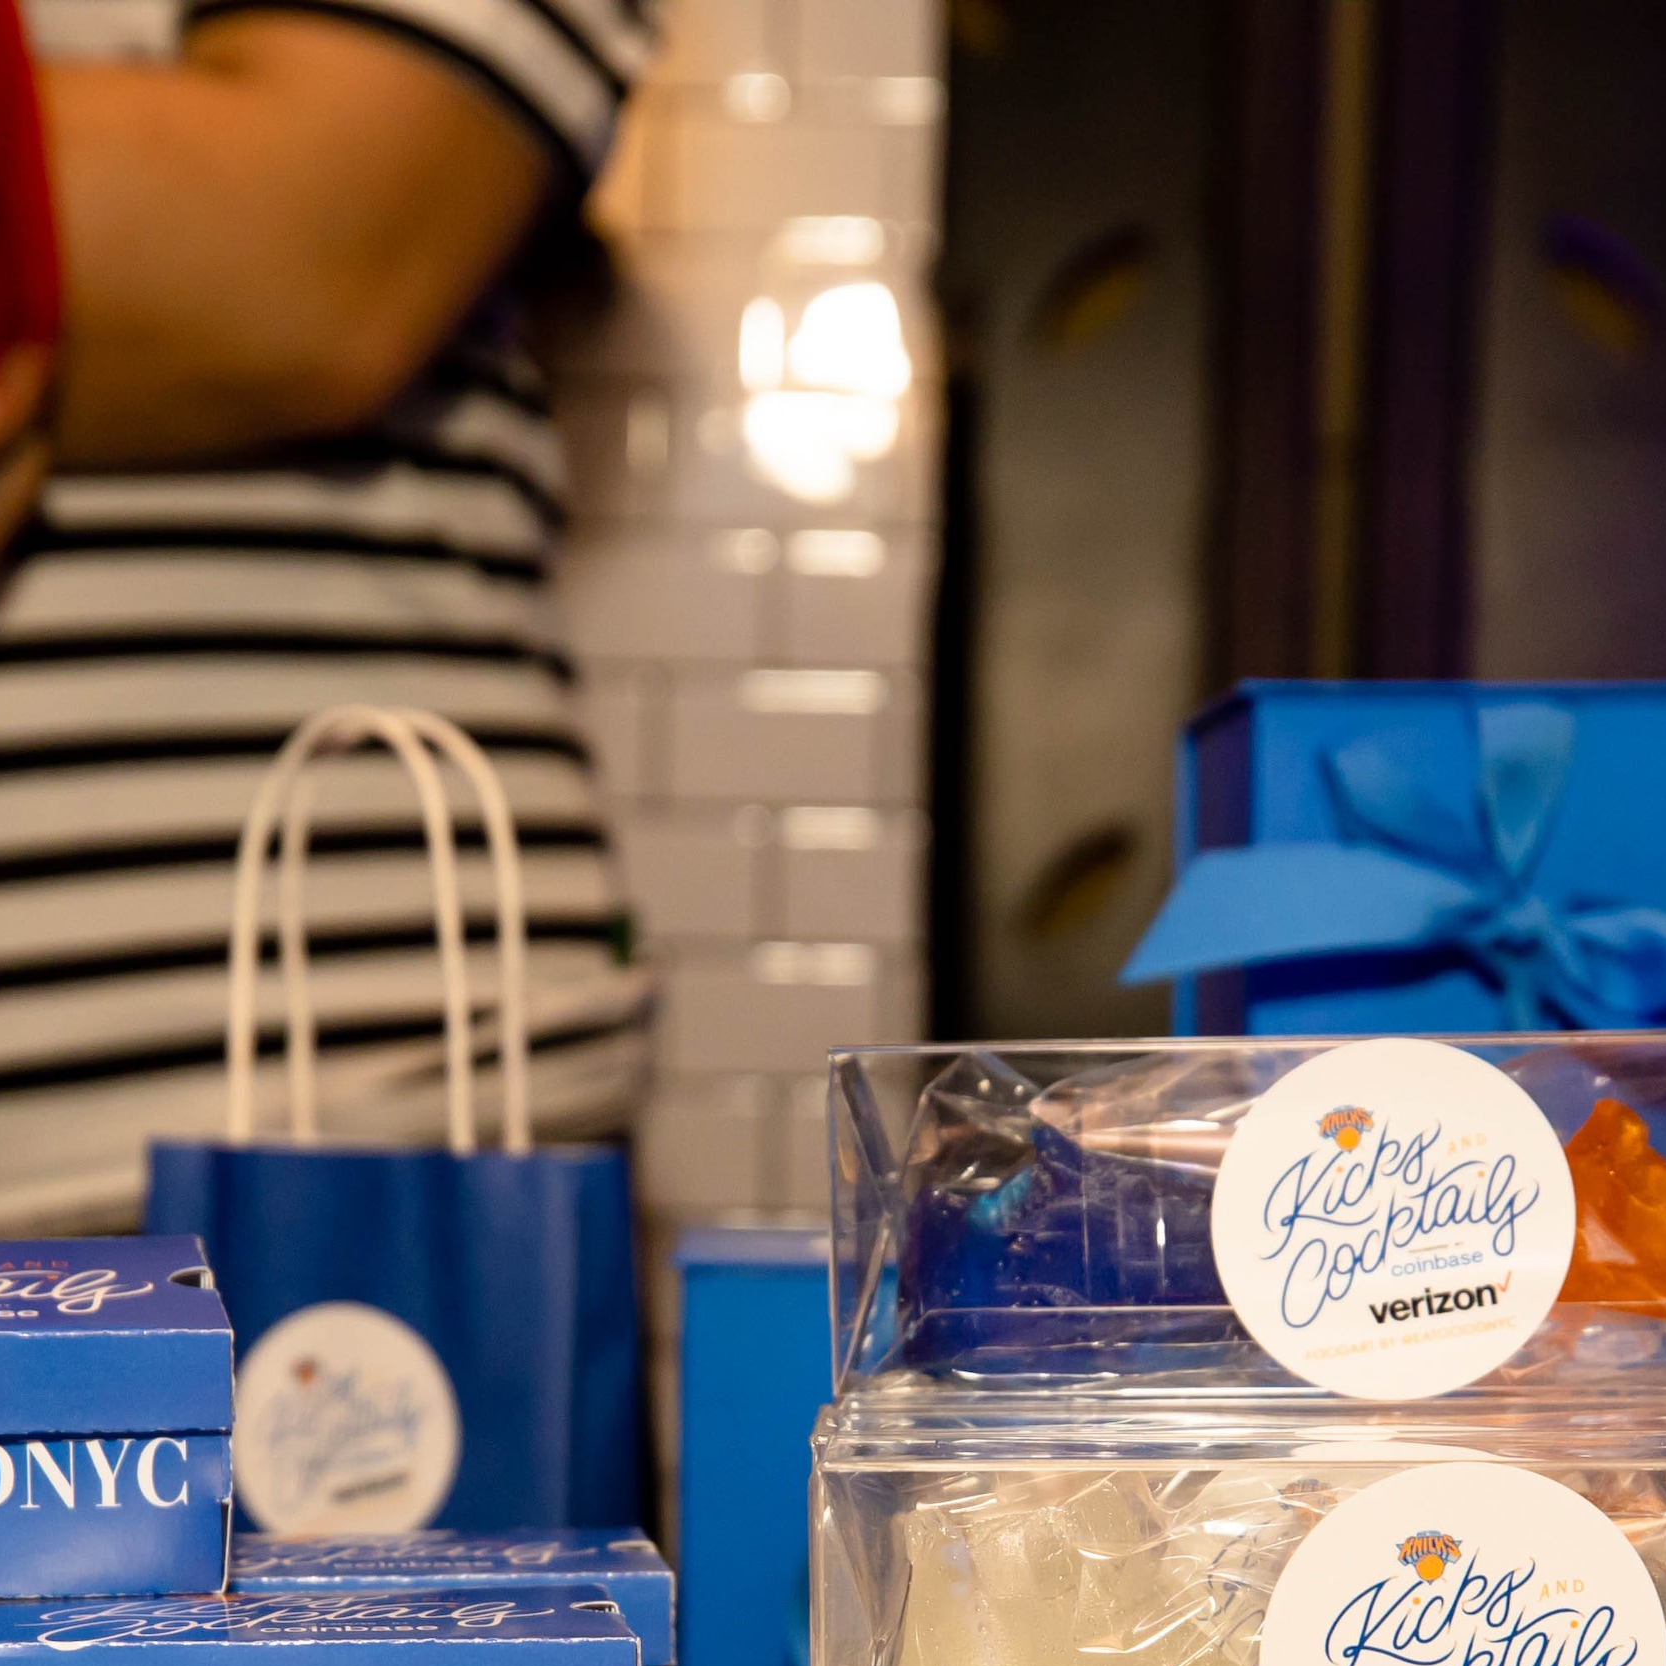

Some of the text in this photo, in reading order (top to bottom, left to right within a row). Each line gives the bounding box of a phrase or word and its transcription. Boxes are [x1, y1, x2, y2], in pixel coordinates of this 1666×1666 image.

[1260, 1119, 1487, 1260] Kicks AND
[1281, 1155, 1540, 1328] Cocktails
[1391, 1249, 1484, 1277] coinbase
[1369, 1281, 1498, 1325] verizon
[1539, 1579, 1585, 1602] AND
[38, 1602, 556, 1647] Cocktails
[260, 1624, 439, 1633] coinbase
